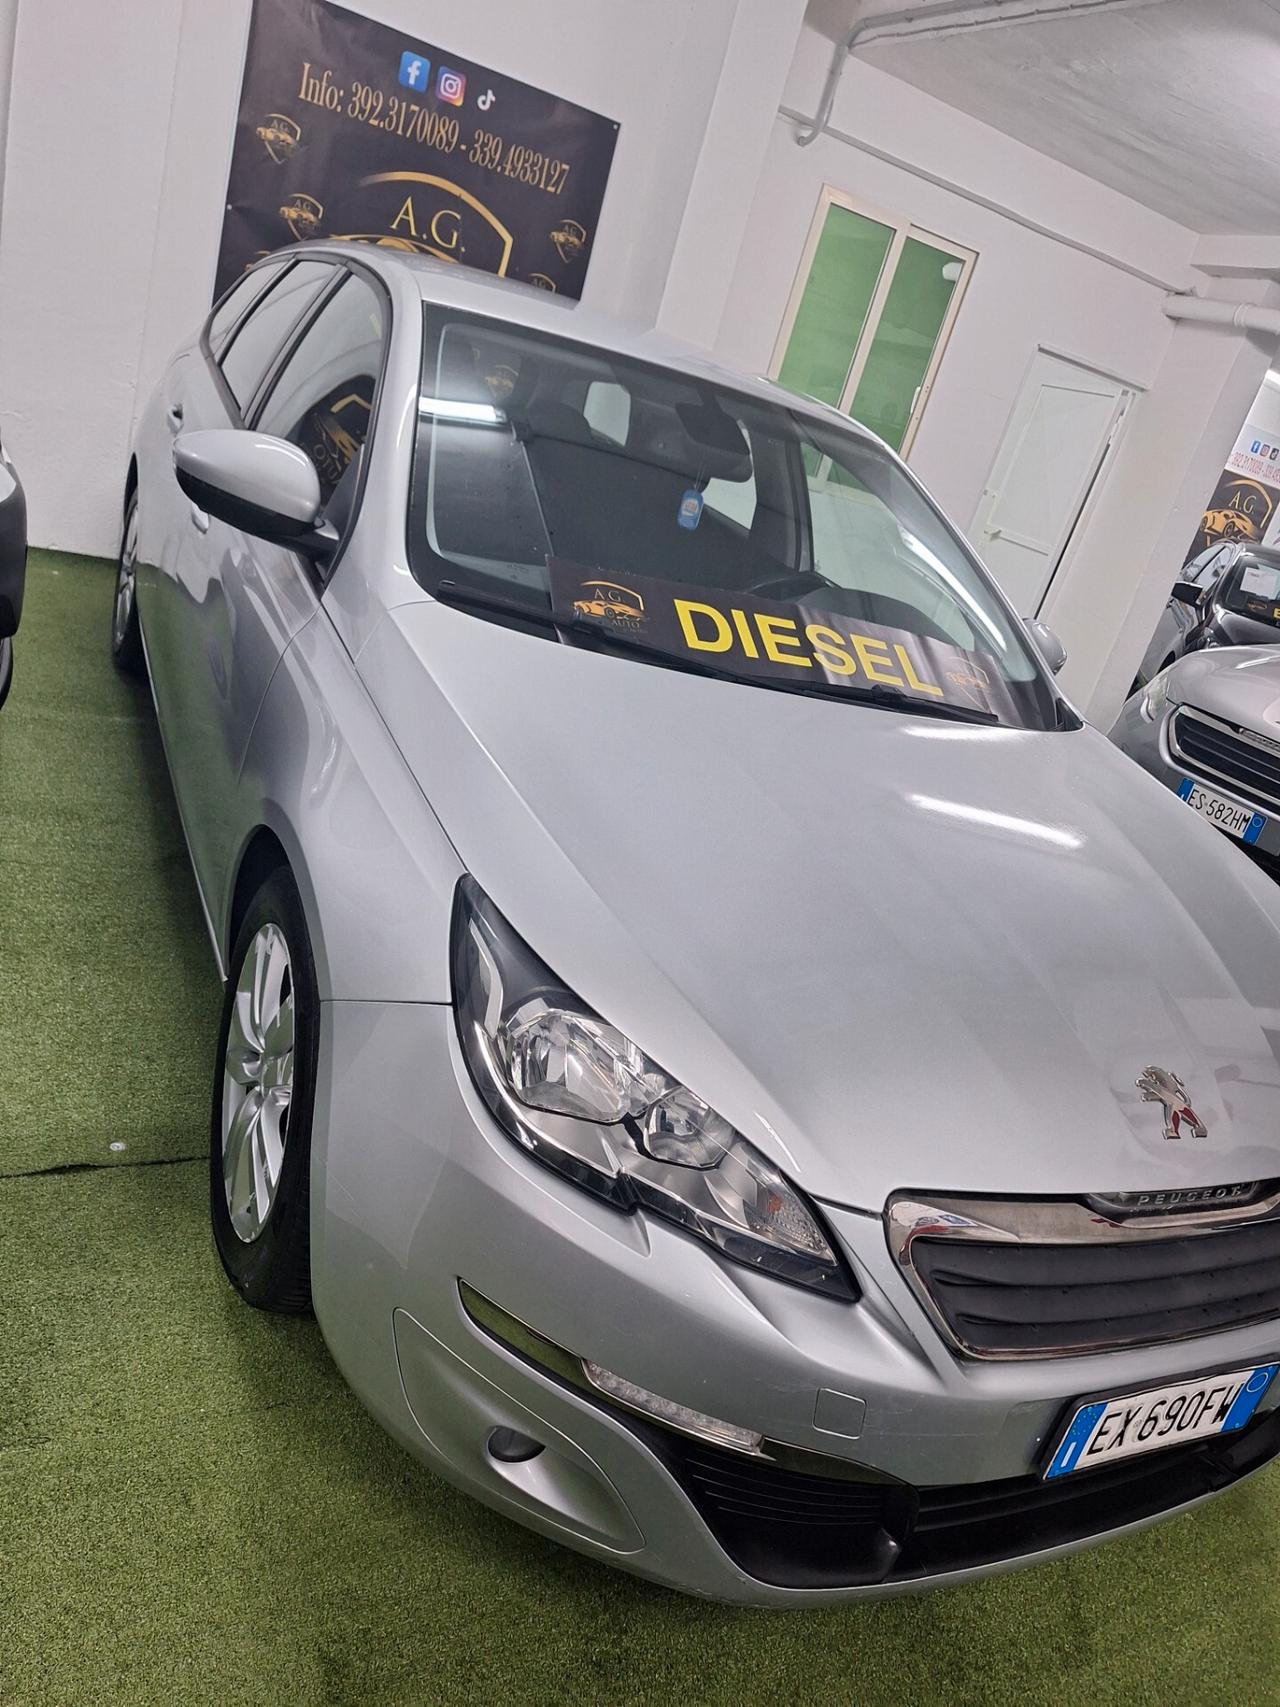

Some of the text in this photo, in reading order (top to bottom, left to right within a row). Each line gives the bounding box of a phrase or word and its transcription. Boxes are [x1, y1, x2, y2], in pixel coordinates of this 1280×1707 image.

[298, 62, 344, 113] Info:
[348, 81, 459, 154] 392.3170089
[469, 129, 570, 195] 339.4933127
[389, 195, 466, 253] A.G.
[674, 598, 944, 697] DIESEL
[1187, 788, 1252, 834] ES 582HM
[1086, 1405, 1143, 1456] EX
[1137, 1382, 1246, 1442] 690FW
